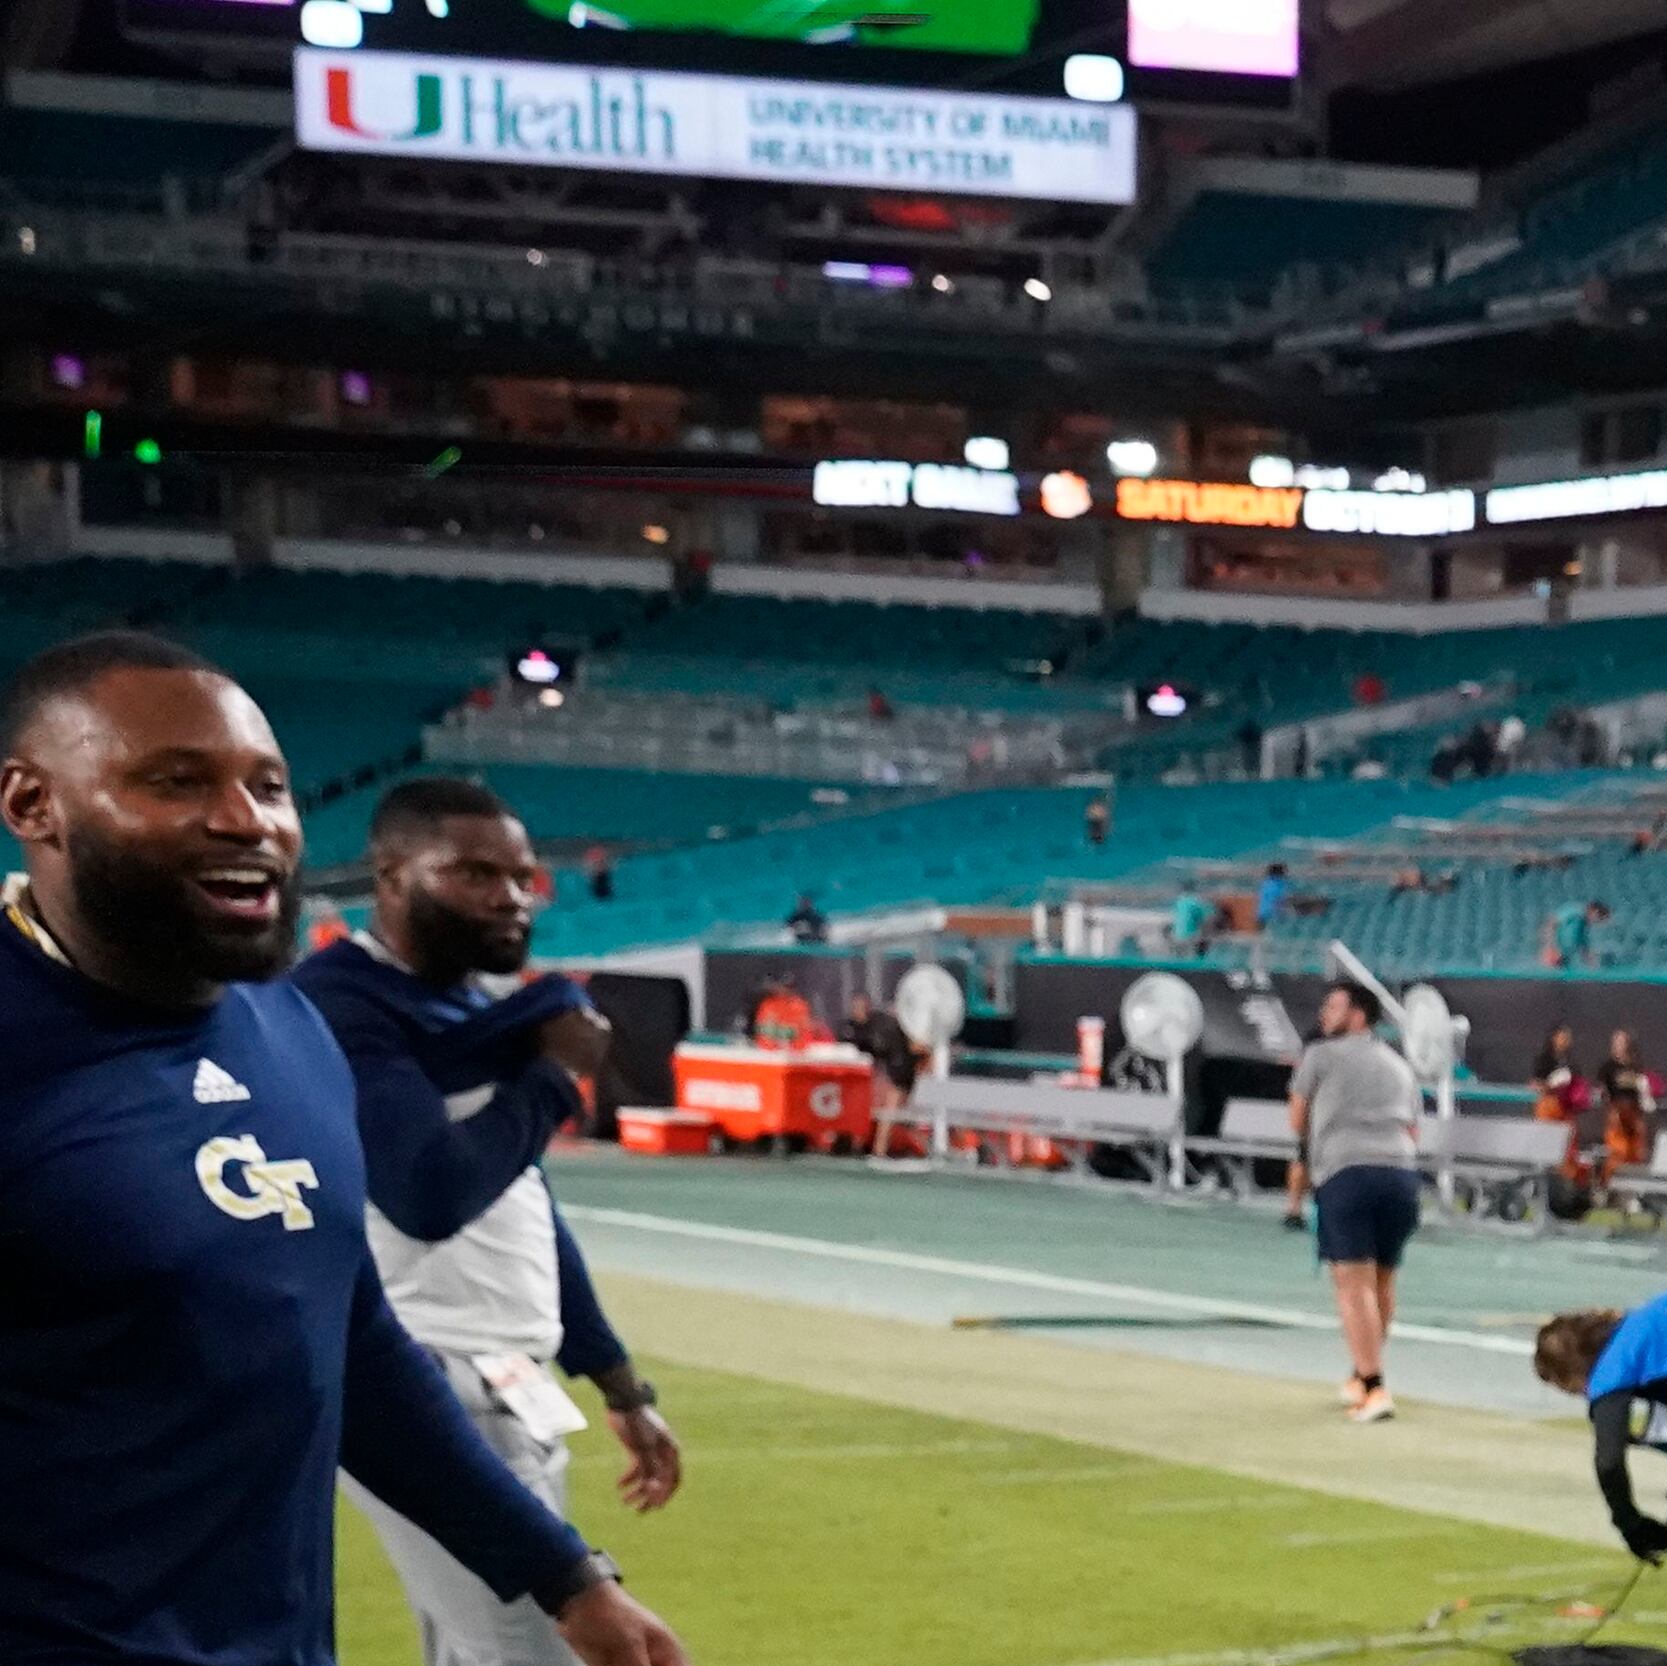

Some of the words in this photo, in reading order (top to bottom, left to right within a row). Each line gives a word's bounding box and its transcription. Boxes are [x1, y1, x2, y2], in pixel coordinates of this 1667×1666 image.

[749, 91, 938, 134] UNIVERSITY
[949, 108, 987, 136] OF
[1004, 113, 1111, 147] MIAMI
[749, 138, 874, 168] HEALTH
[883, 147, 1013, 180] SYSTEM
[195, 1134, 320, 1231] GT
